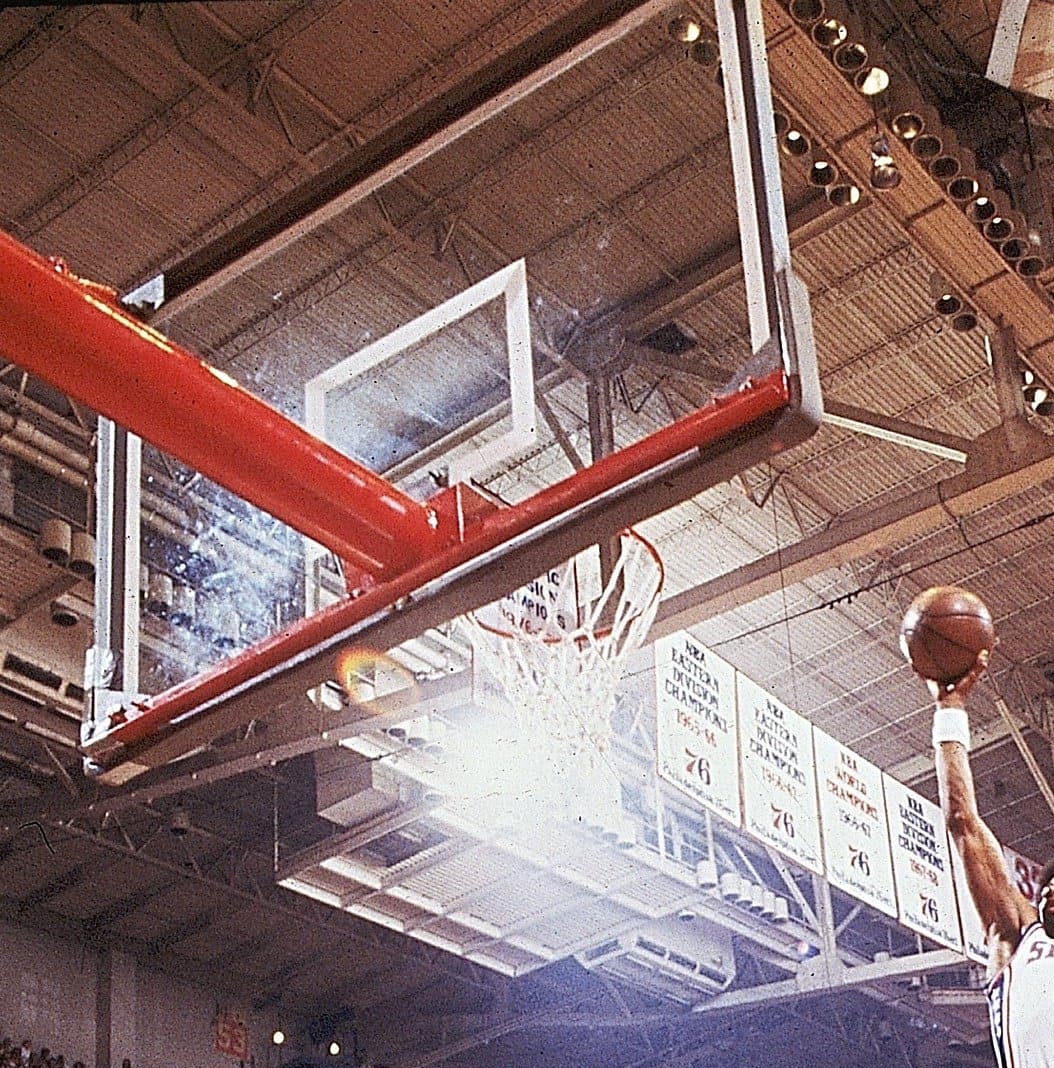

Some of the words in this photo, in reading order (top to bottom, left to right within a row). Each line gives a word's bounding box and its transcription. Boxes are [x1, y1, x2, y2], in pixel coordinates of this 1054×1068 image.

[671, 647, 720, 692] EASTERN
[672, 666, 720, 710] DIVISION
[664, 678, 728, 734] CHAMPIONS
[754, 707, 798, 749] EASTERN
[684, 747, 711, 787] 76
[749, 737, 807, 787] CHAMPIONS
[770, 802, 796, 839] 76
[898, 803, 937, 839] EASTERN
[848, 844, 871, 877] 76
[898, 833, 945, 873] CHAMPIONS
[918, 892, 940, 924] 76
